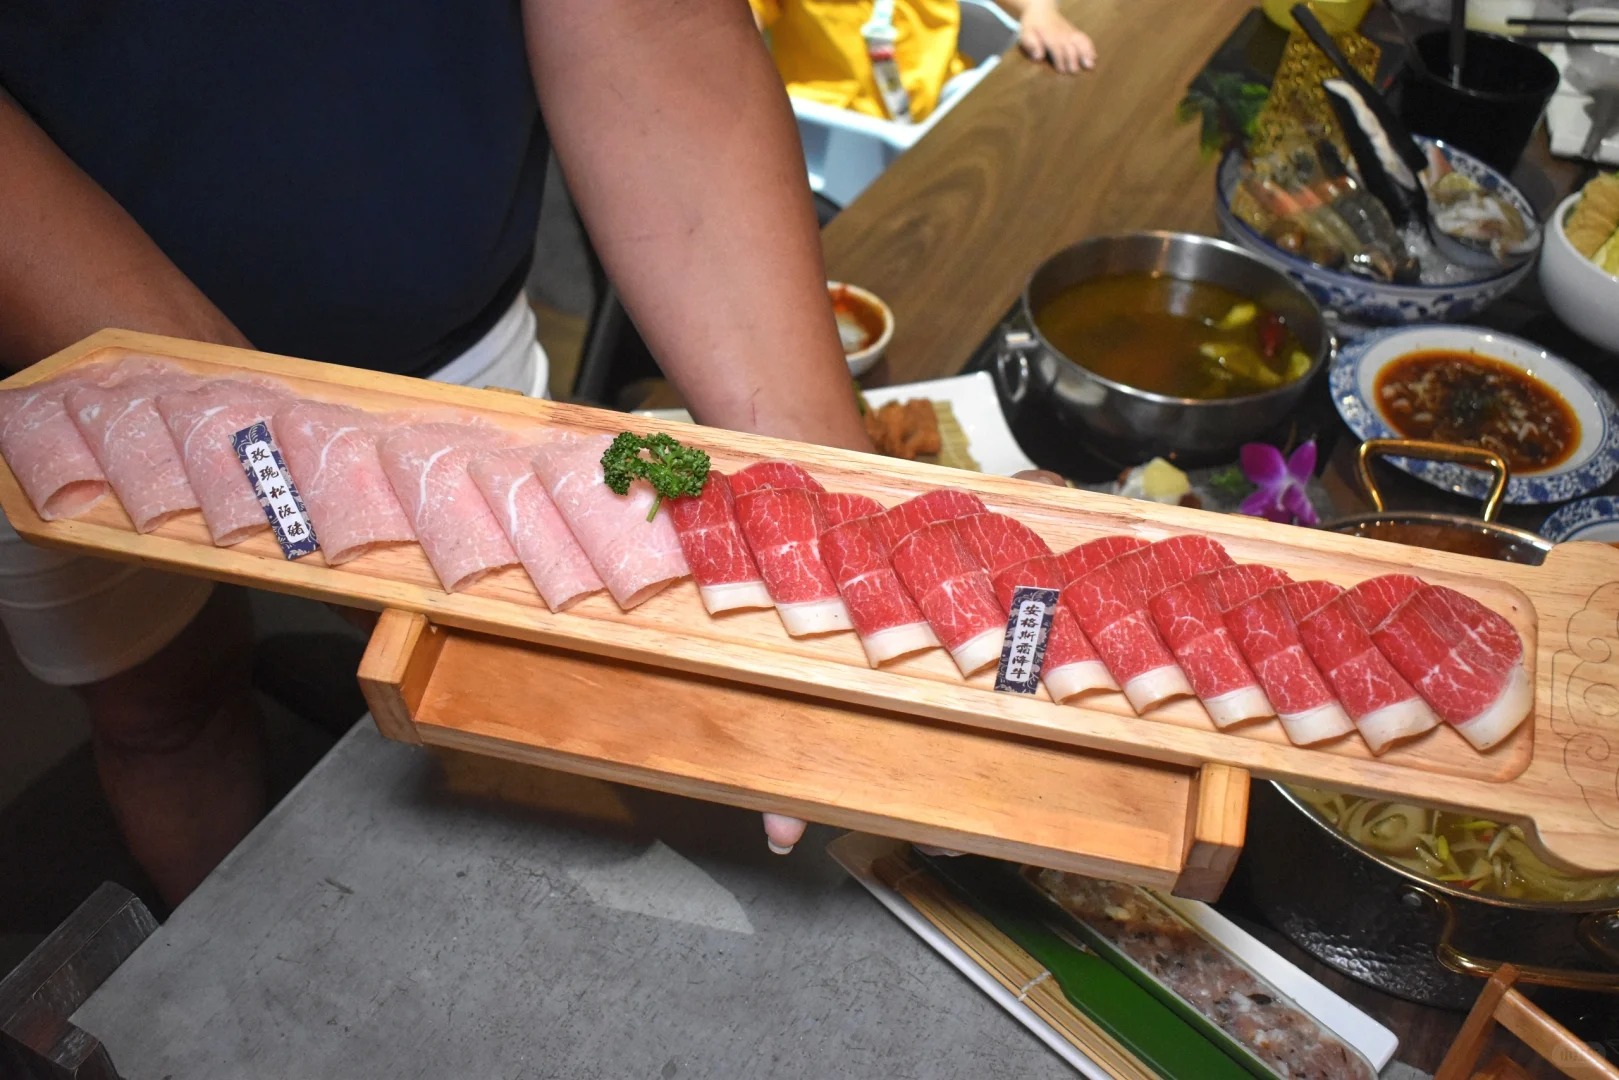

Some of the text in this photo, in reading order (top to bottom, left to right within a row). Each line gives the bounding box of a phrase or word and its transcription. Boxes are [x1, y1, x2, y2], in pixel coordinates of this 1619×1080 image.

[1010, 604, 1042, 679] 安格斯霜降牛
